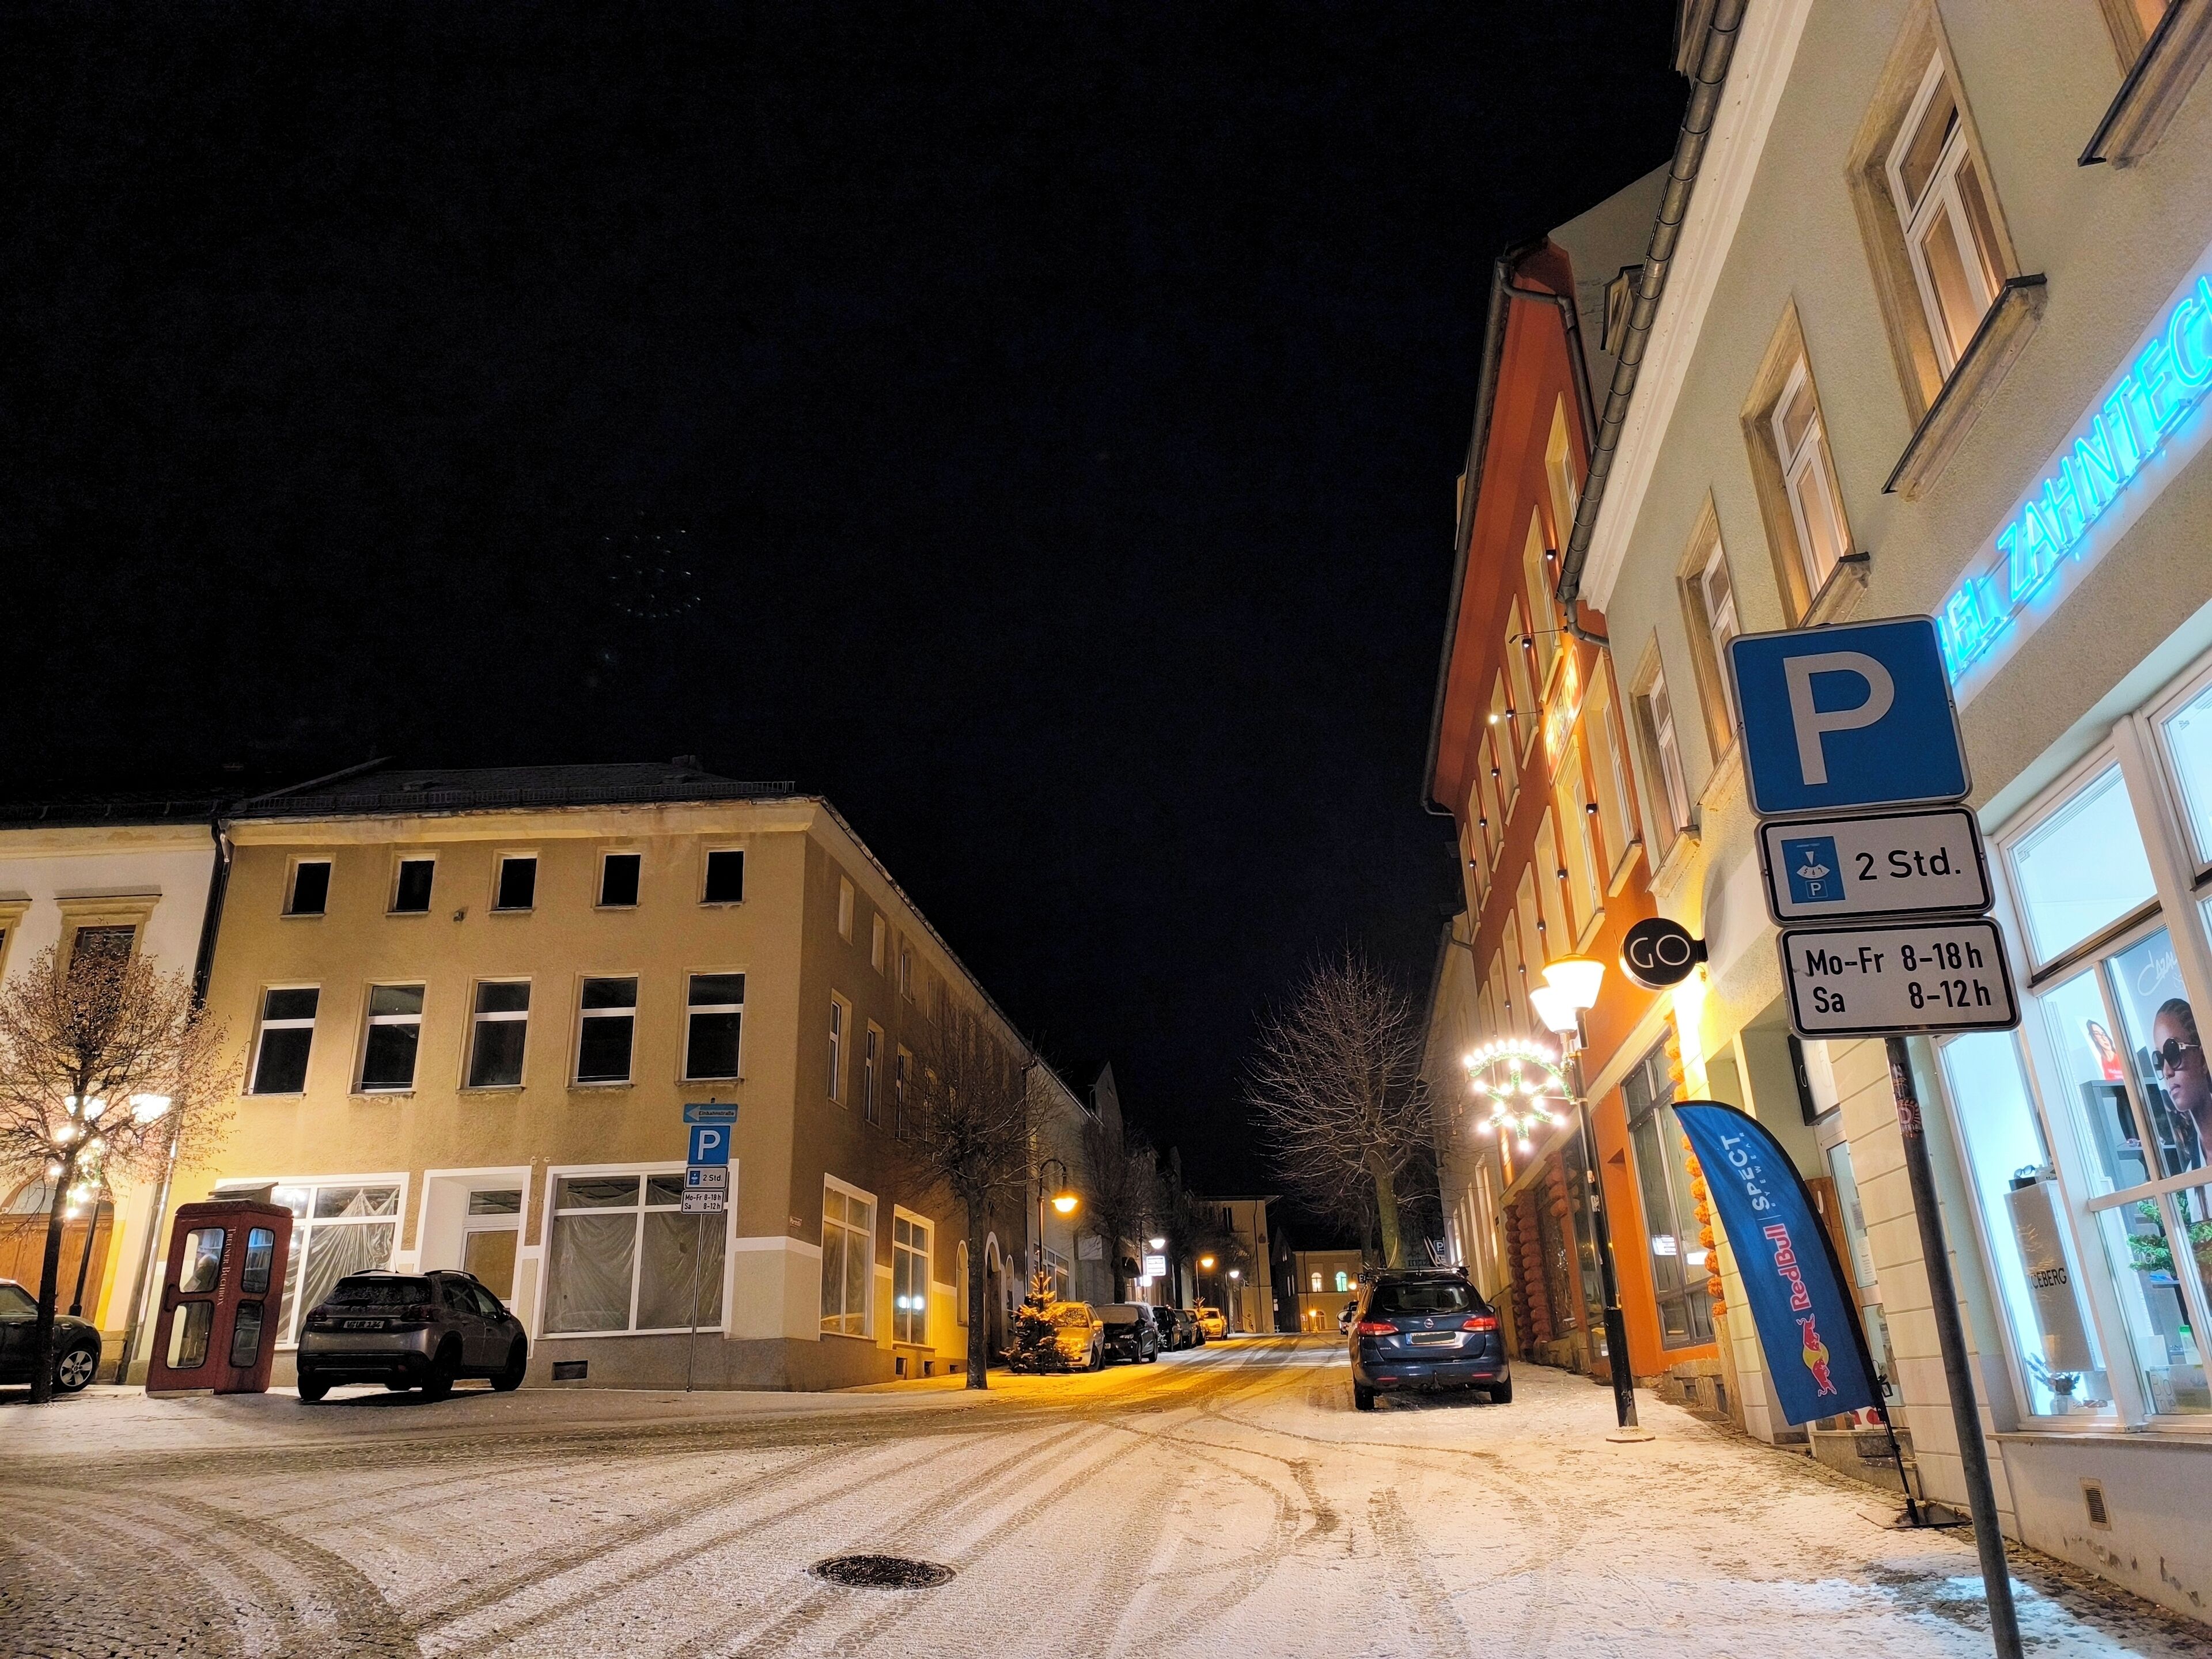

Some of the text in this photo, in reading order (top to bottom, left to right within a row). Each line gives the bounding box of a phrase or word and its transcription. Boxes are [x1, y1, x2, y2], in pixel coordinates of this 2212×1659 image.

[1783, 650, 1895, 785] P
[1855, 847, 1961, 881] 2 Std.
[1810, 882, 1821, 896] P
[1630, 934, 1690, 968] GO
[1806, 946, 1884, 977] Mo-Fr
[1813, 986, 1846, 1014] Sa
[698, 1130, 721, 1160] P
[1720, 1135, 1770, 1210] SPECT
